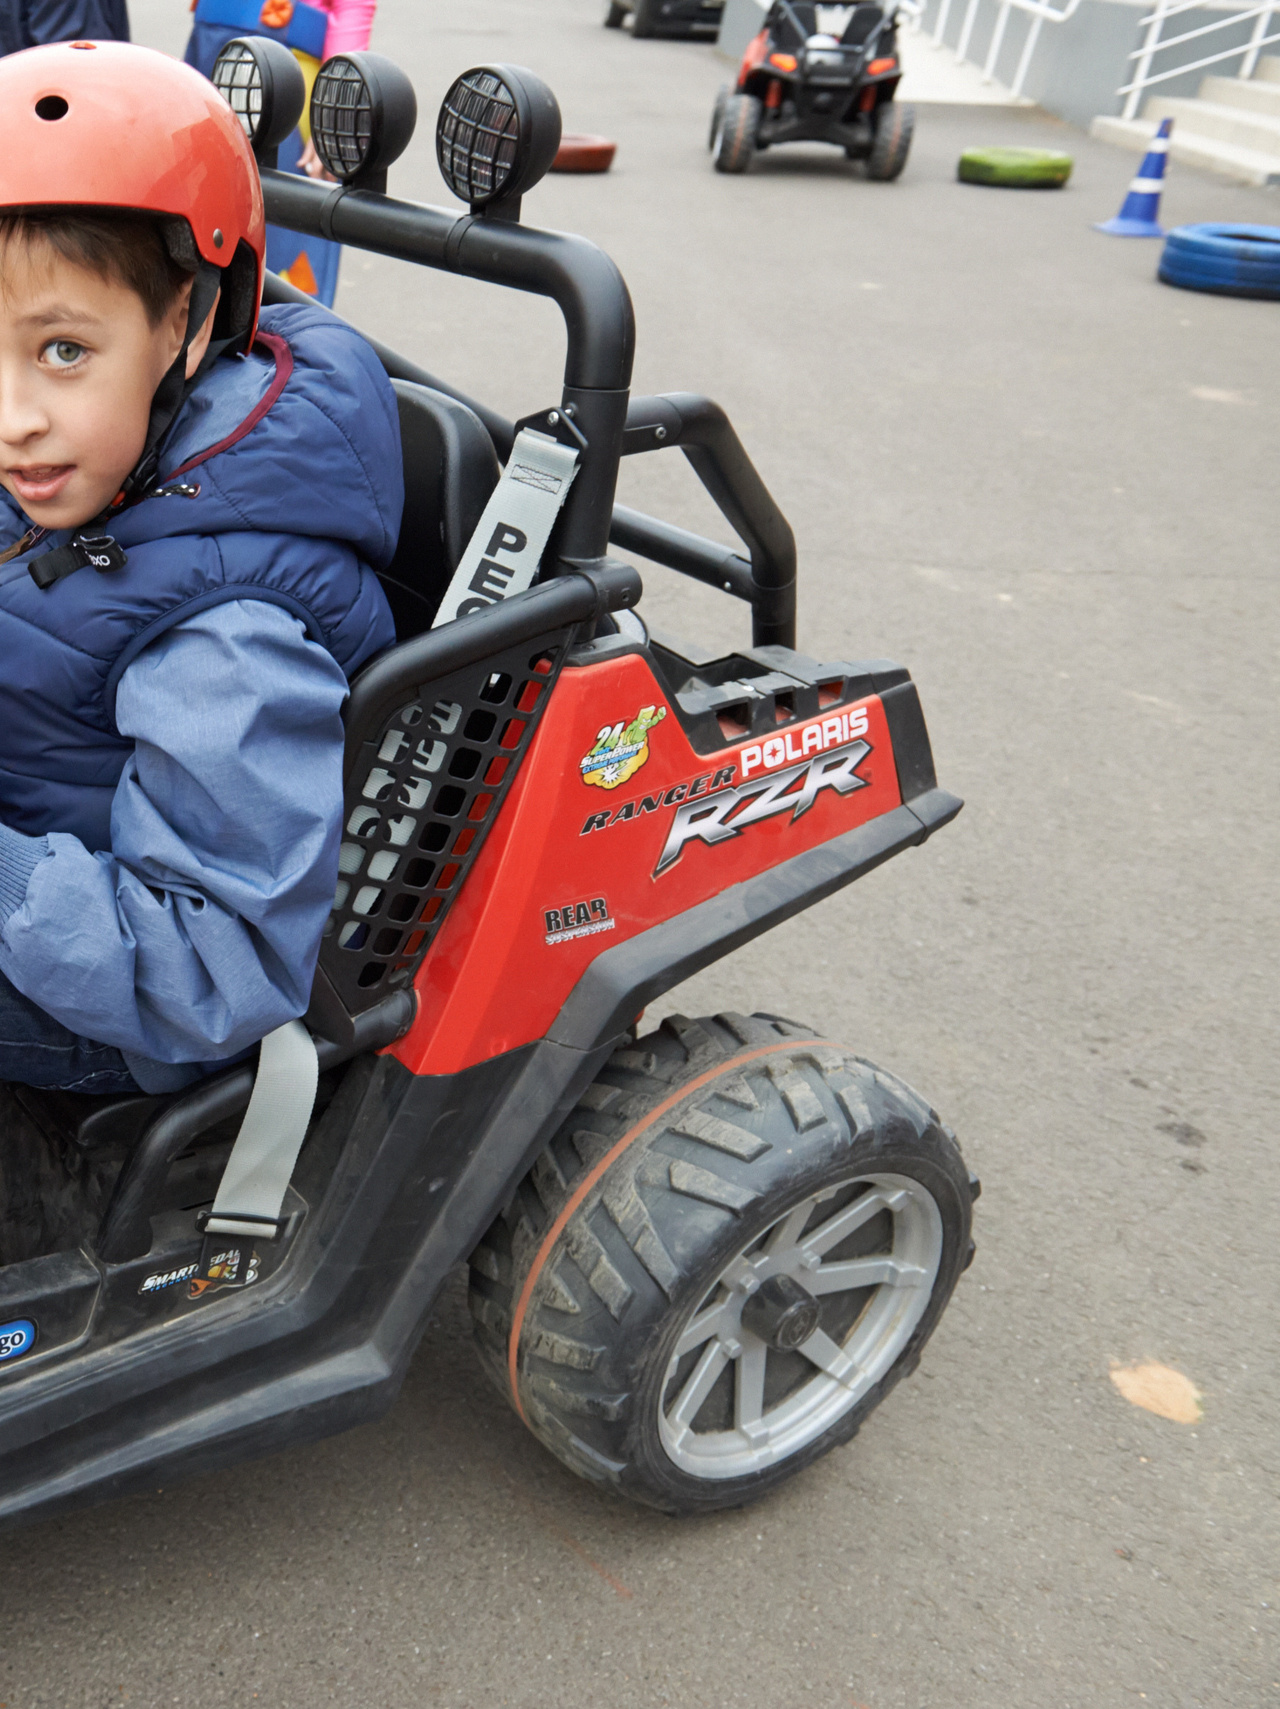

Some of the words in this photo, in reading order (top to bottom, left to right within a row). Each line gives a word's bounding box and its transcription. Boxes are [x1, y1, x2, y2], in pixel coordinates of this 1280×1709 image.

[590, 722, 625, 756] 24
[740, 707, 869, 777] POLARIS
[579, 764, 738, 836] RANGER
[652, 739, 873, 879] RZR
[544, 897, 608, 933] REAR
